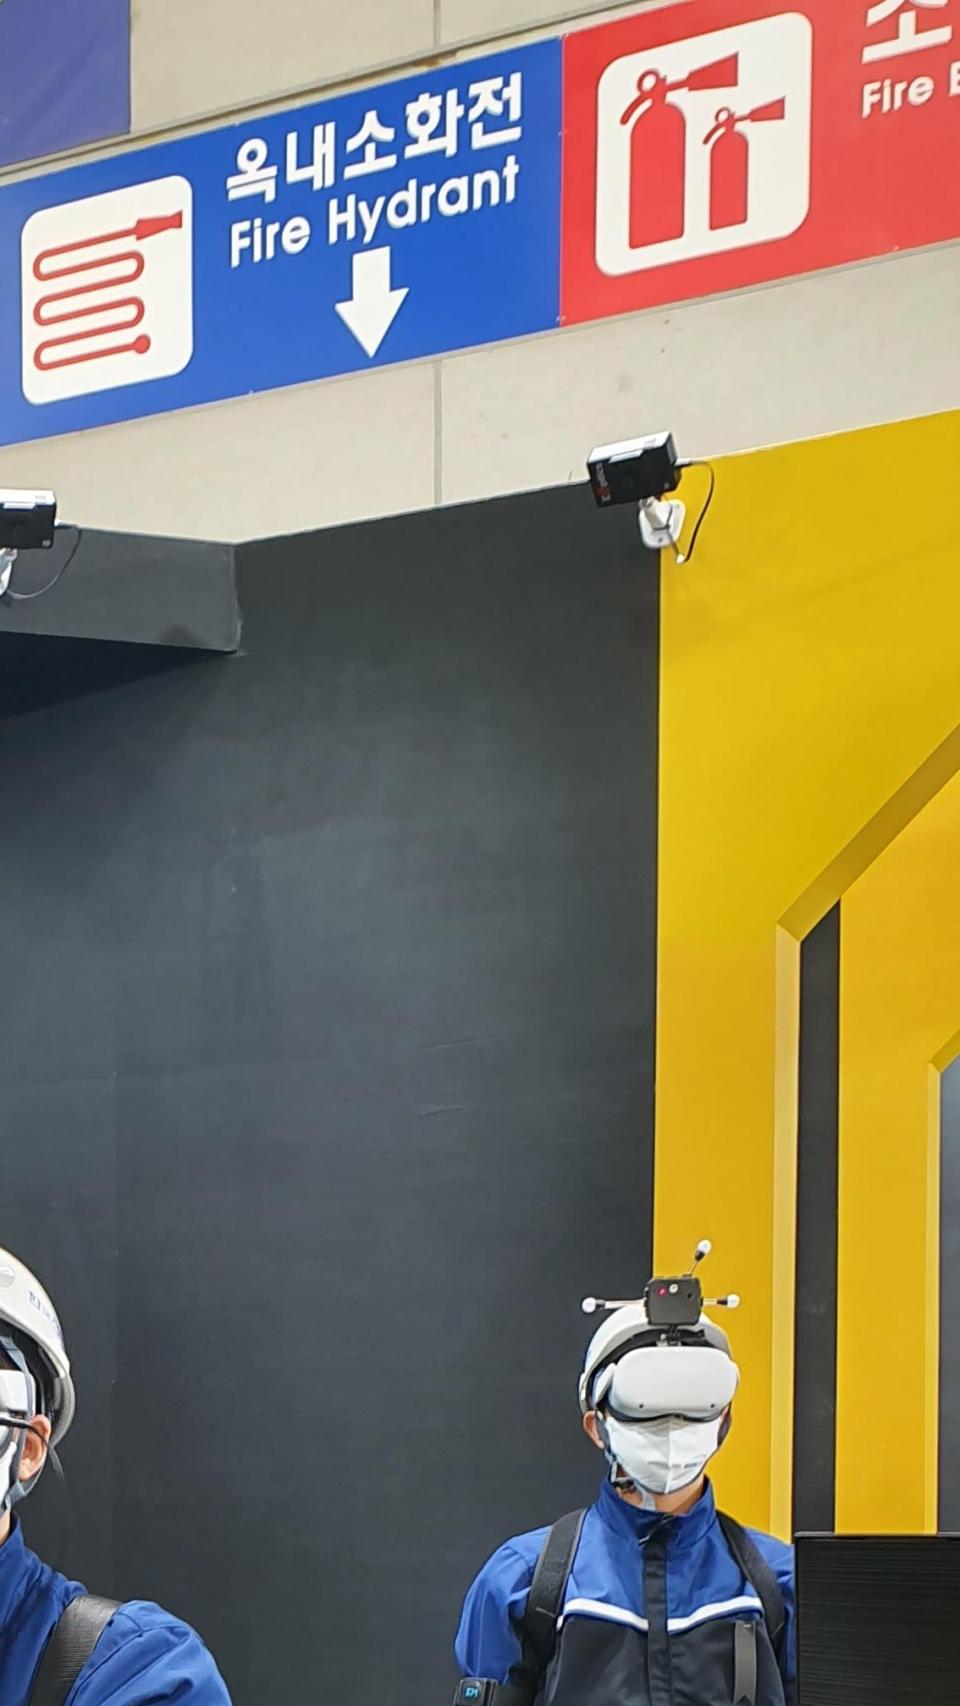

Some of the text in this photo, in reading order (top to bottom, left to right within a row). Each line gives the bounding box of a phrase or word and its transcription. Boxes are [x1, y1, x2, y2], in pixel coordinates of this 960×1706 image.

[226, 71, 522, 204] 옥내소화전
[862, 75, 935, 119] Fire
[230, 154, 520, 269] Fire Hydrant
